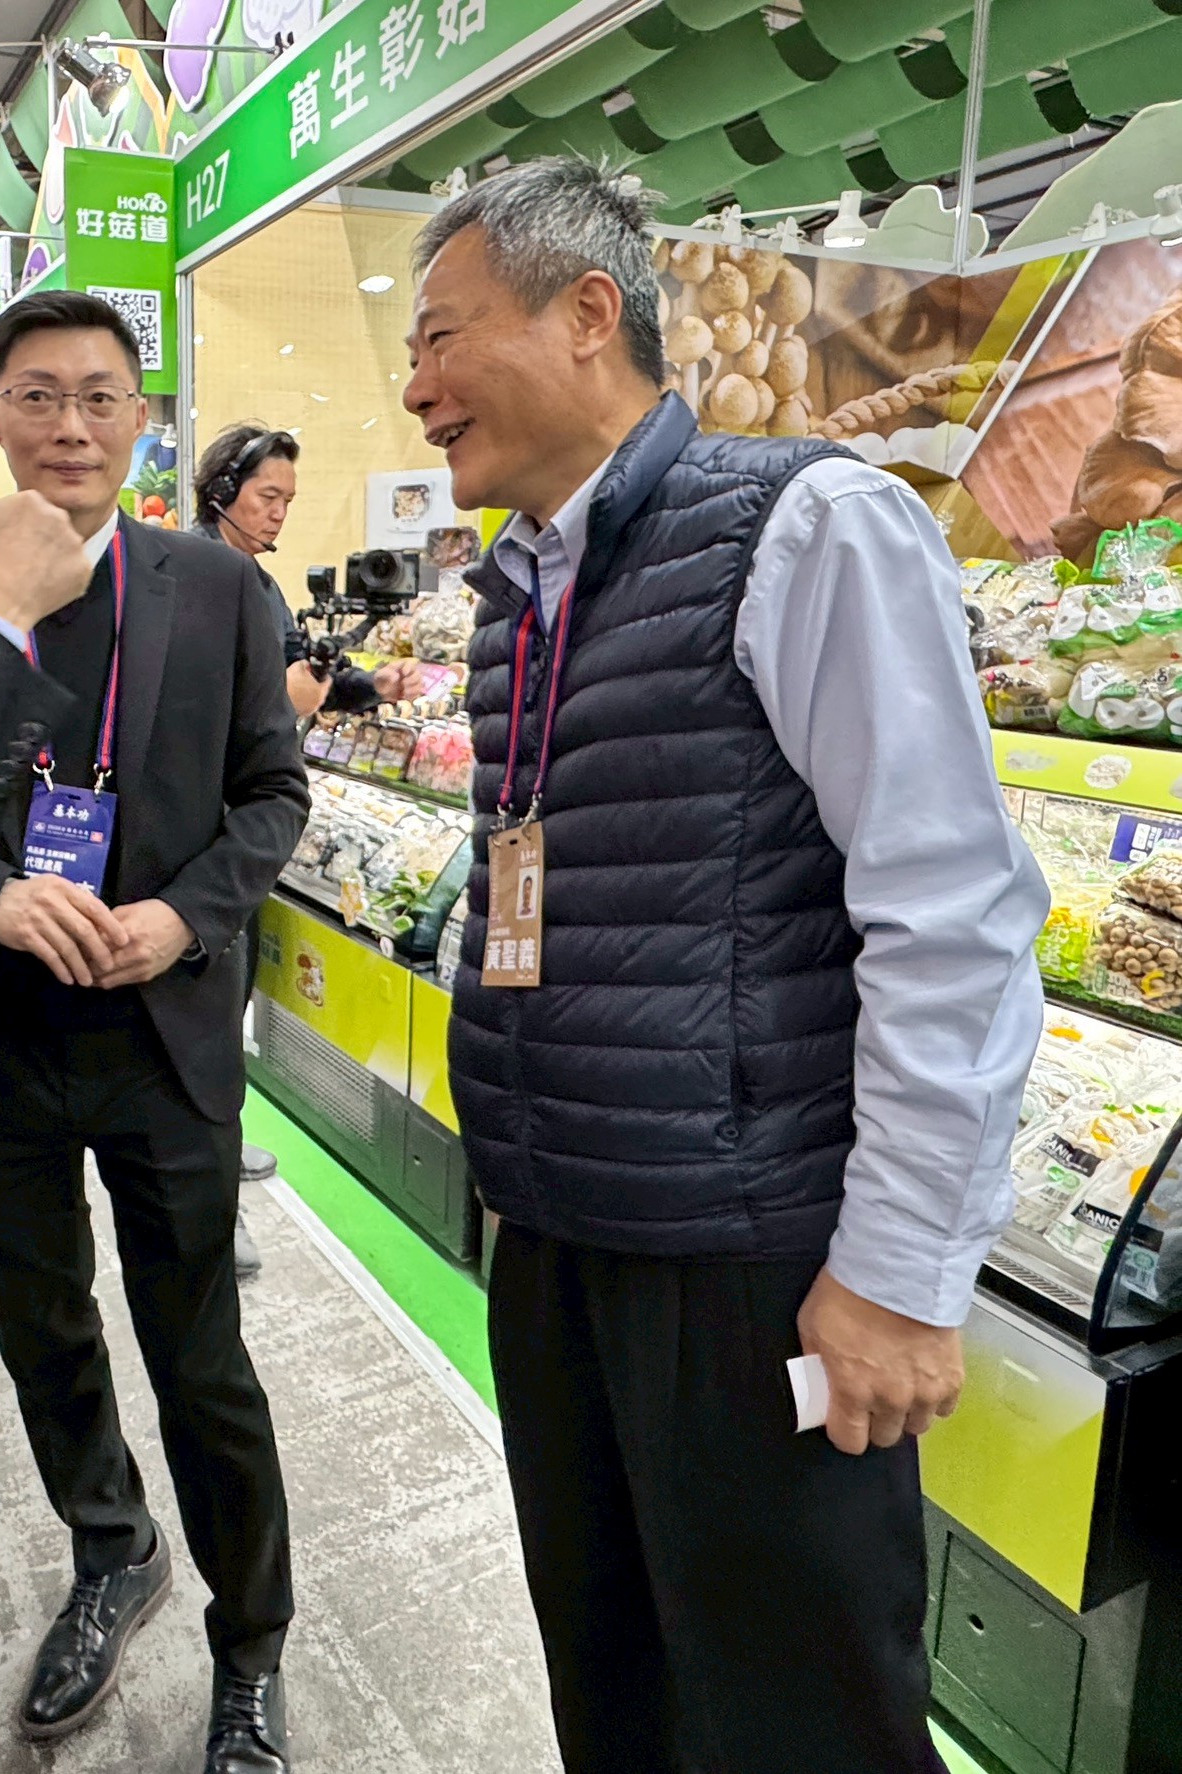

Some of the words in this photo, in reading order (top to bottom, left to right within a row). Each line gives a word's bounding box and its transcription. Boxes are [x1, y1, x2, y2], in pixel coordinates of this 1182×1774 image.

[186, 150, 230, 229] H27
[76, 207, 168, 243] 好菇道
[53, 804, 89, 821] 基本功
